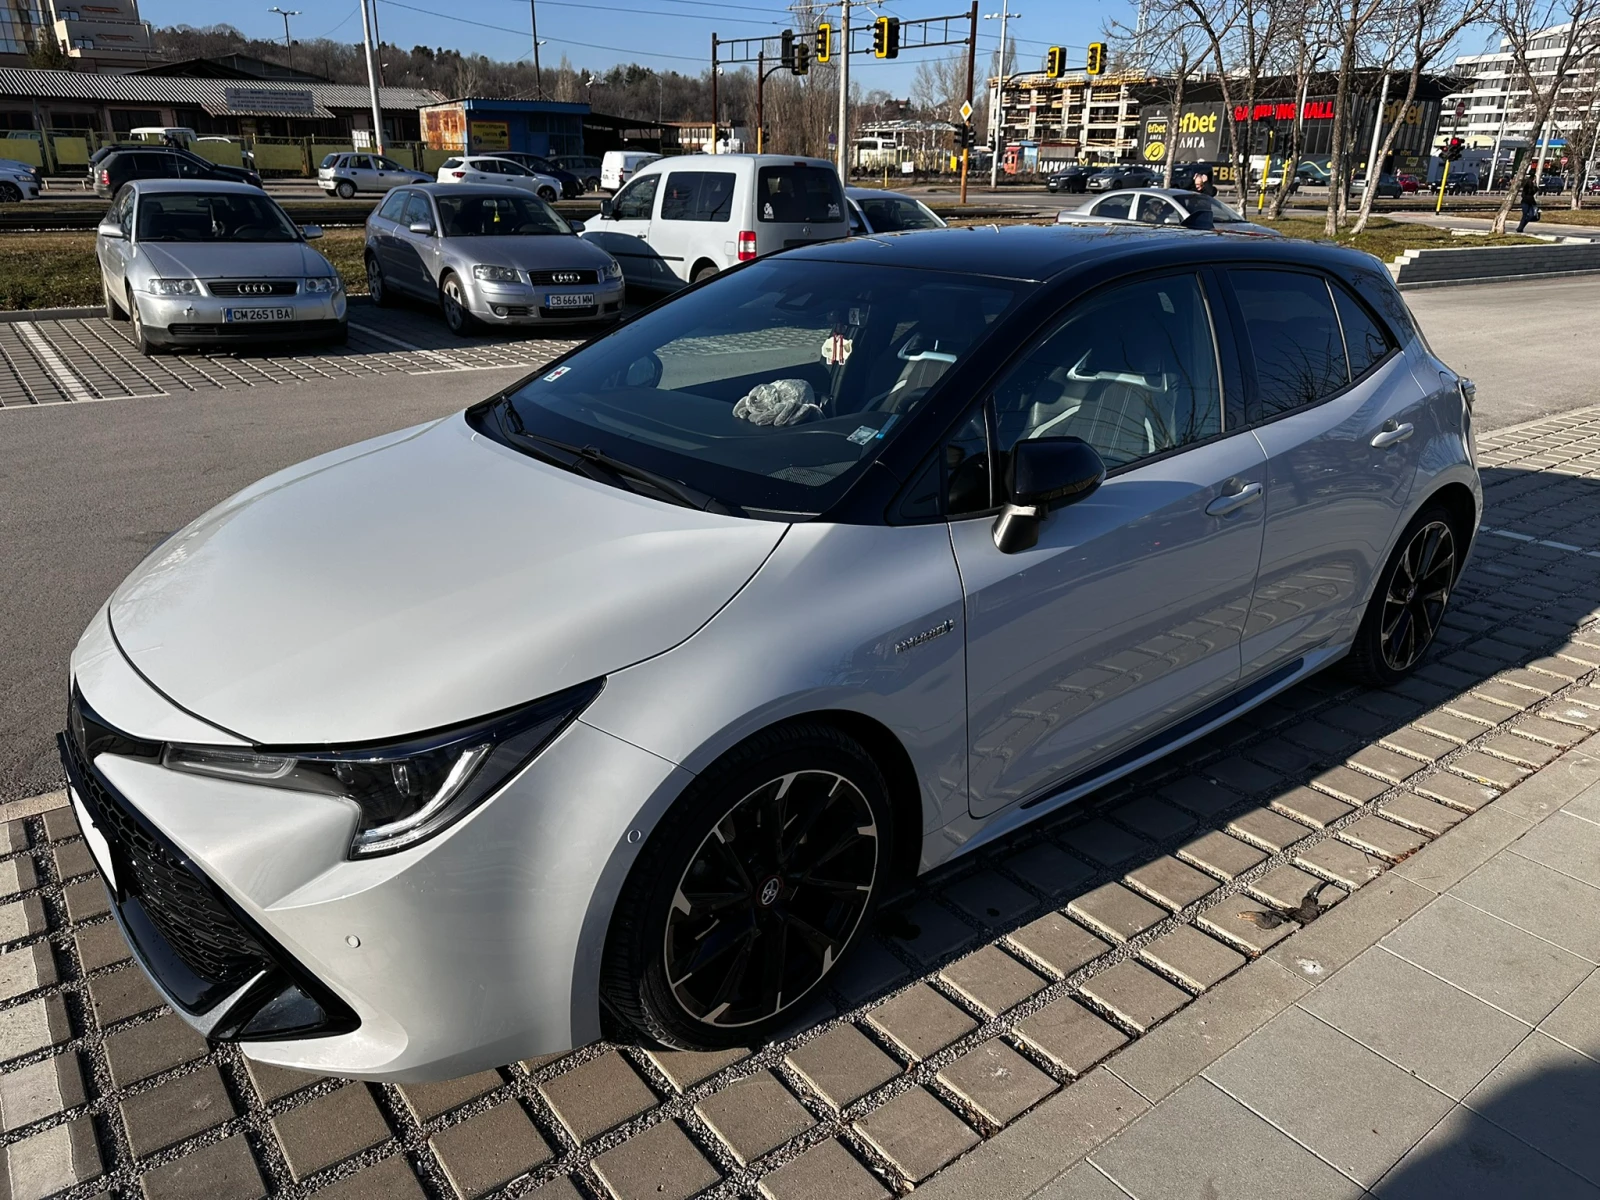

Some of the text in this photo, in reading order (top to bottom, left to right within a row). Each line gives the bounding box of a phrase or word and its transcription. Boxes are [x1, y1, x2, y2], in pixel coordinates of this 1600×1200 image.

[1179, 136, 1205, 148] ЛИГА
[551, 295, 562, 306] CB
[563, 295, 581, 305] 6661
[233, 309, 291, 320] CM 2651 BA
